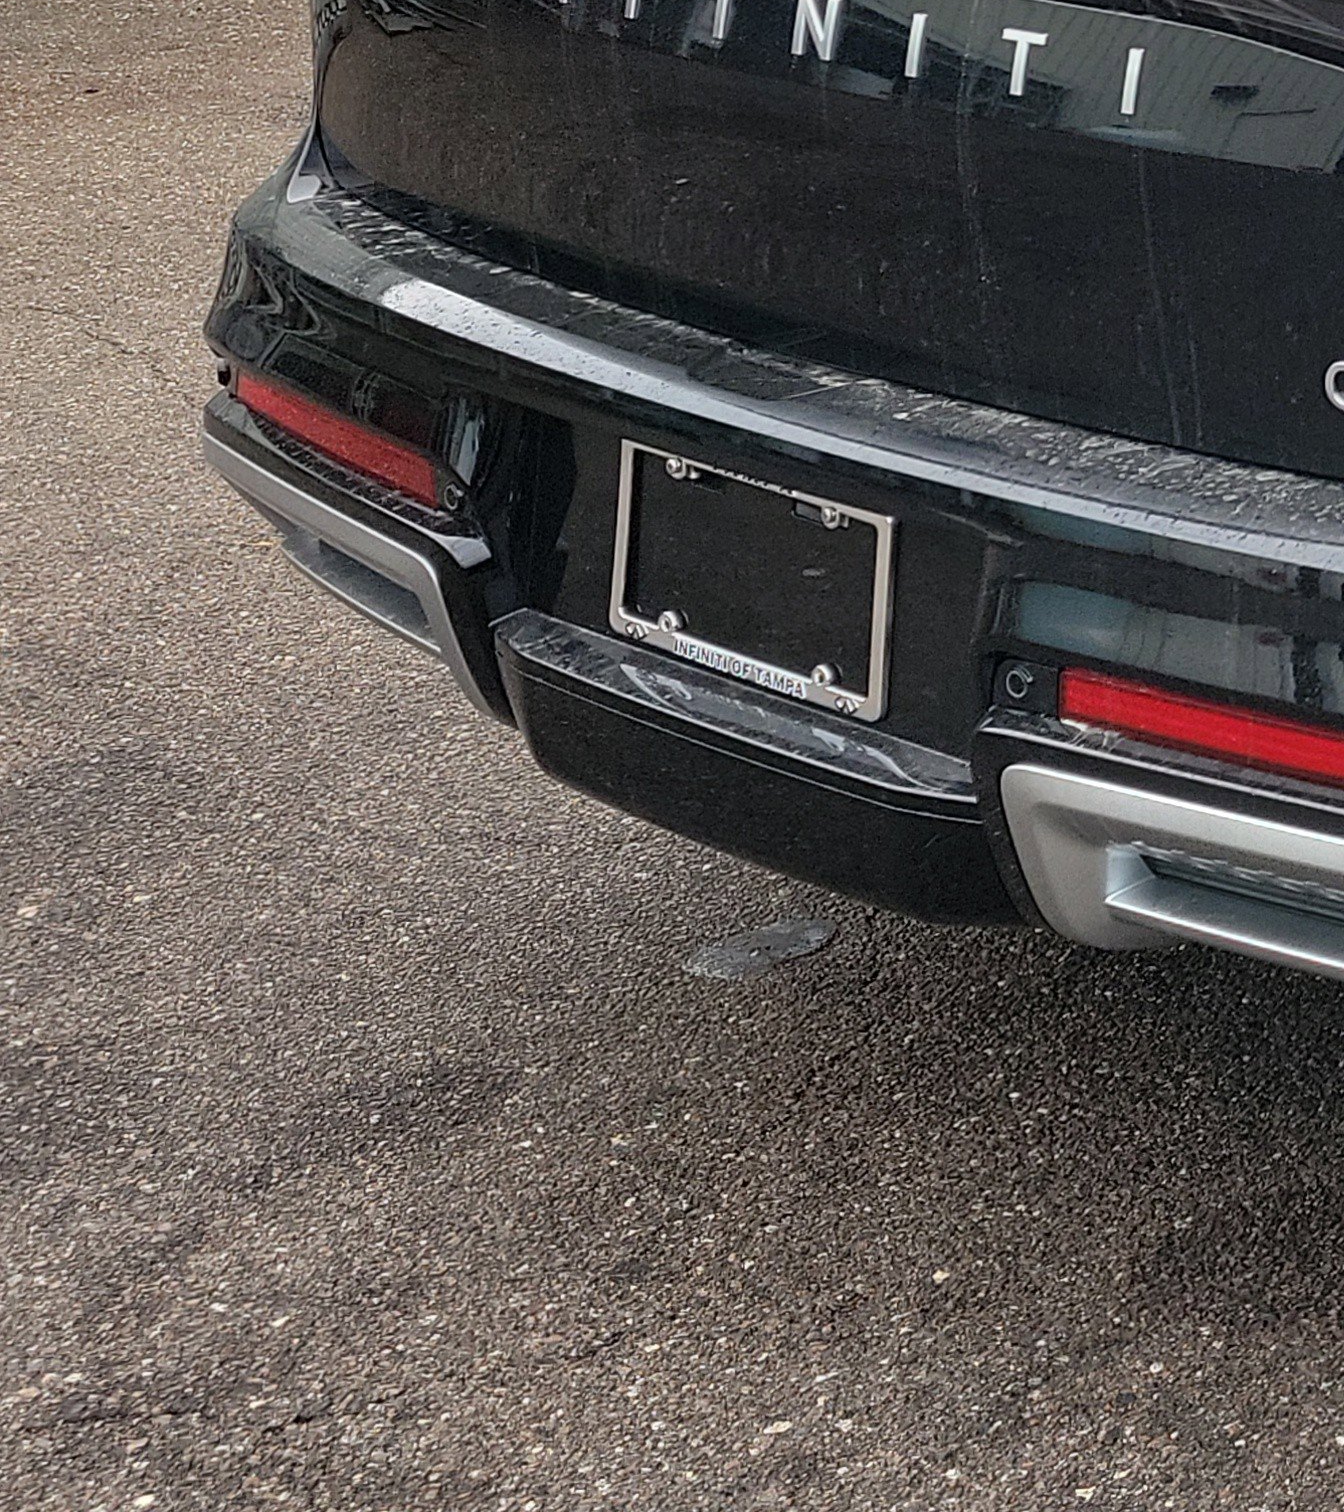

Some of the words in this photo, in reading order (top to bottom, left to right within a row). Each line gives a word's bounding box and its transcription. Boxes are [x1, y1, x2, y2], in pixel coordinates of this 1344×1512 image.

[673, 639, 728, 670] INFINITI
[731, 659, 750, 677] OF
[754, 668, 805, 698] TAMPA
